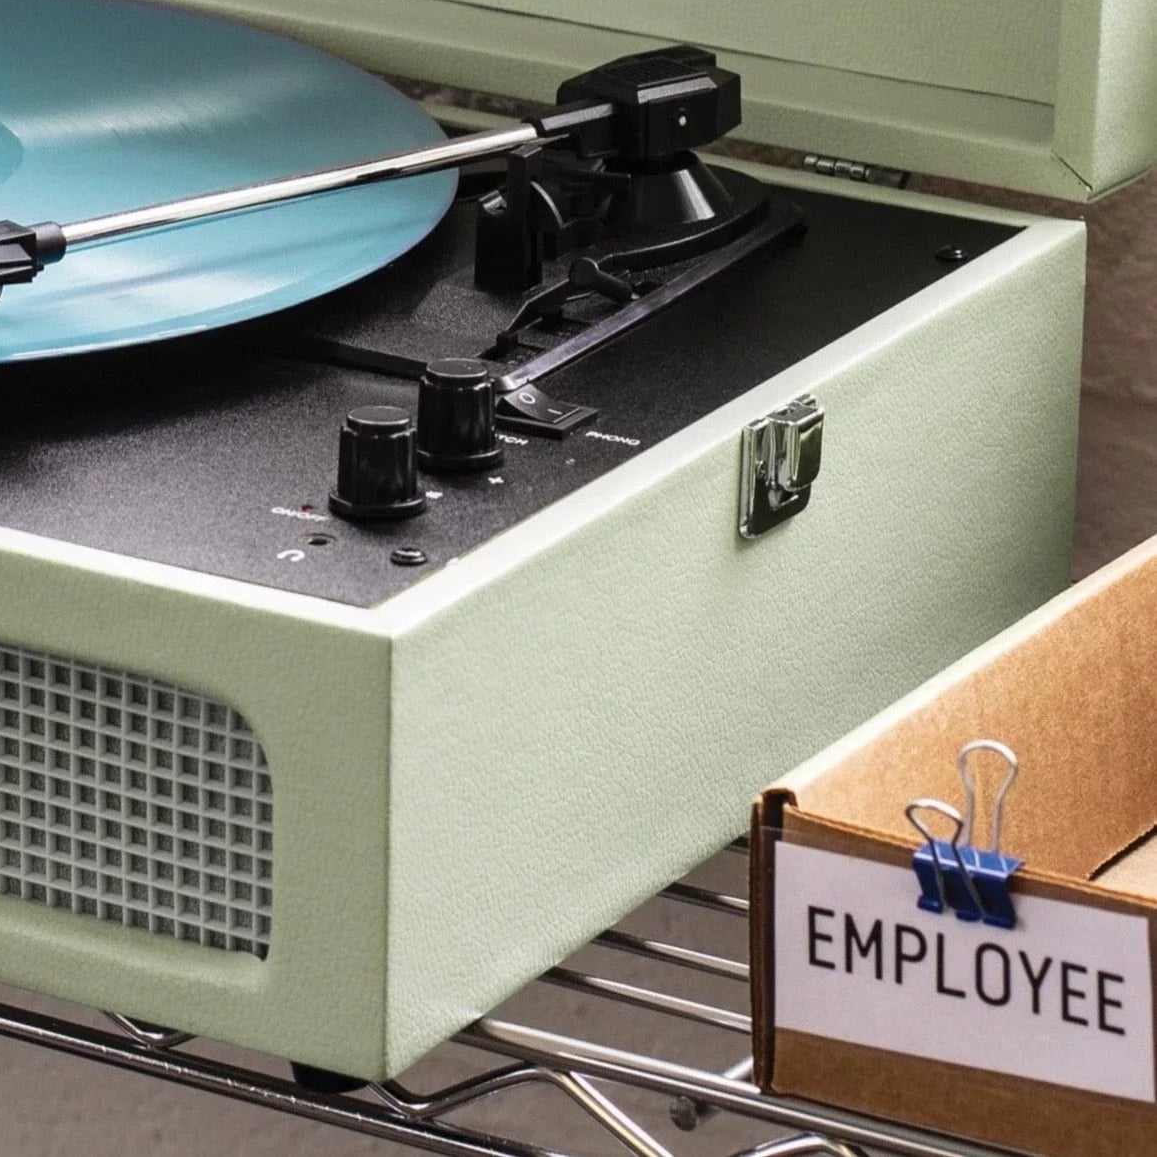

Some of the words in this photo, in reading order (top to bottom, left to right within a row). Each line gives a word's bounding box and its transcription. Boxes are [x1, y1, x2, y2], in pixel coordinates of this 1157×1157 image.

[495, 433, 529, 446] TCH
[585, 430, 641, 446] PHONO
[808, 905, 1126, 1036] EMPLOYEE
